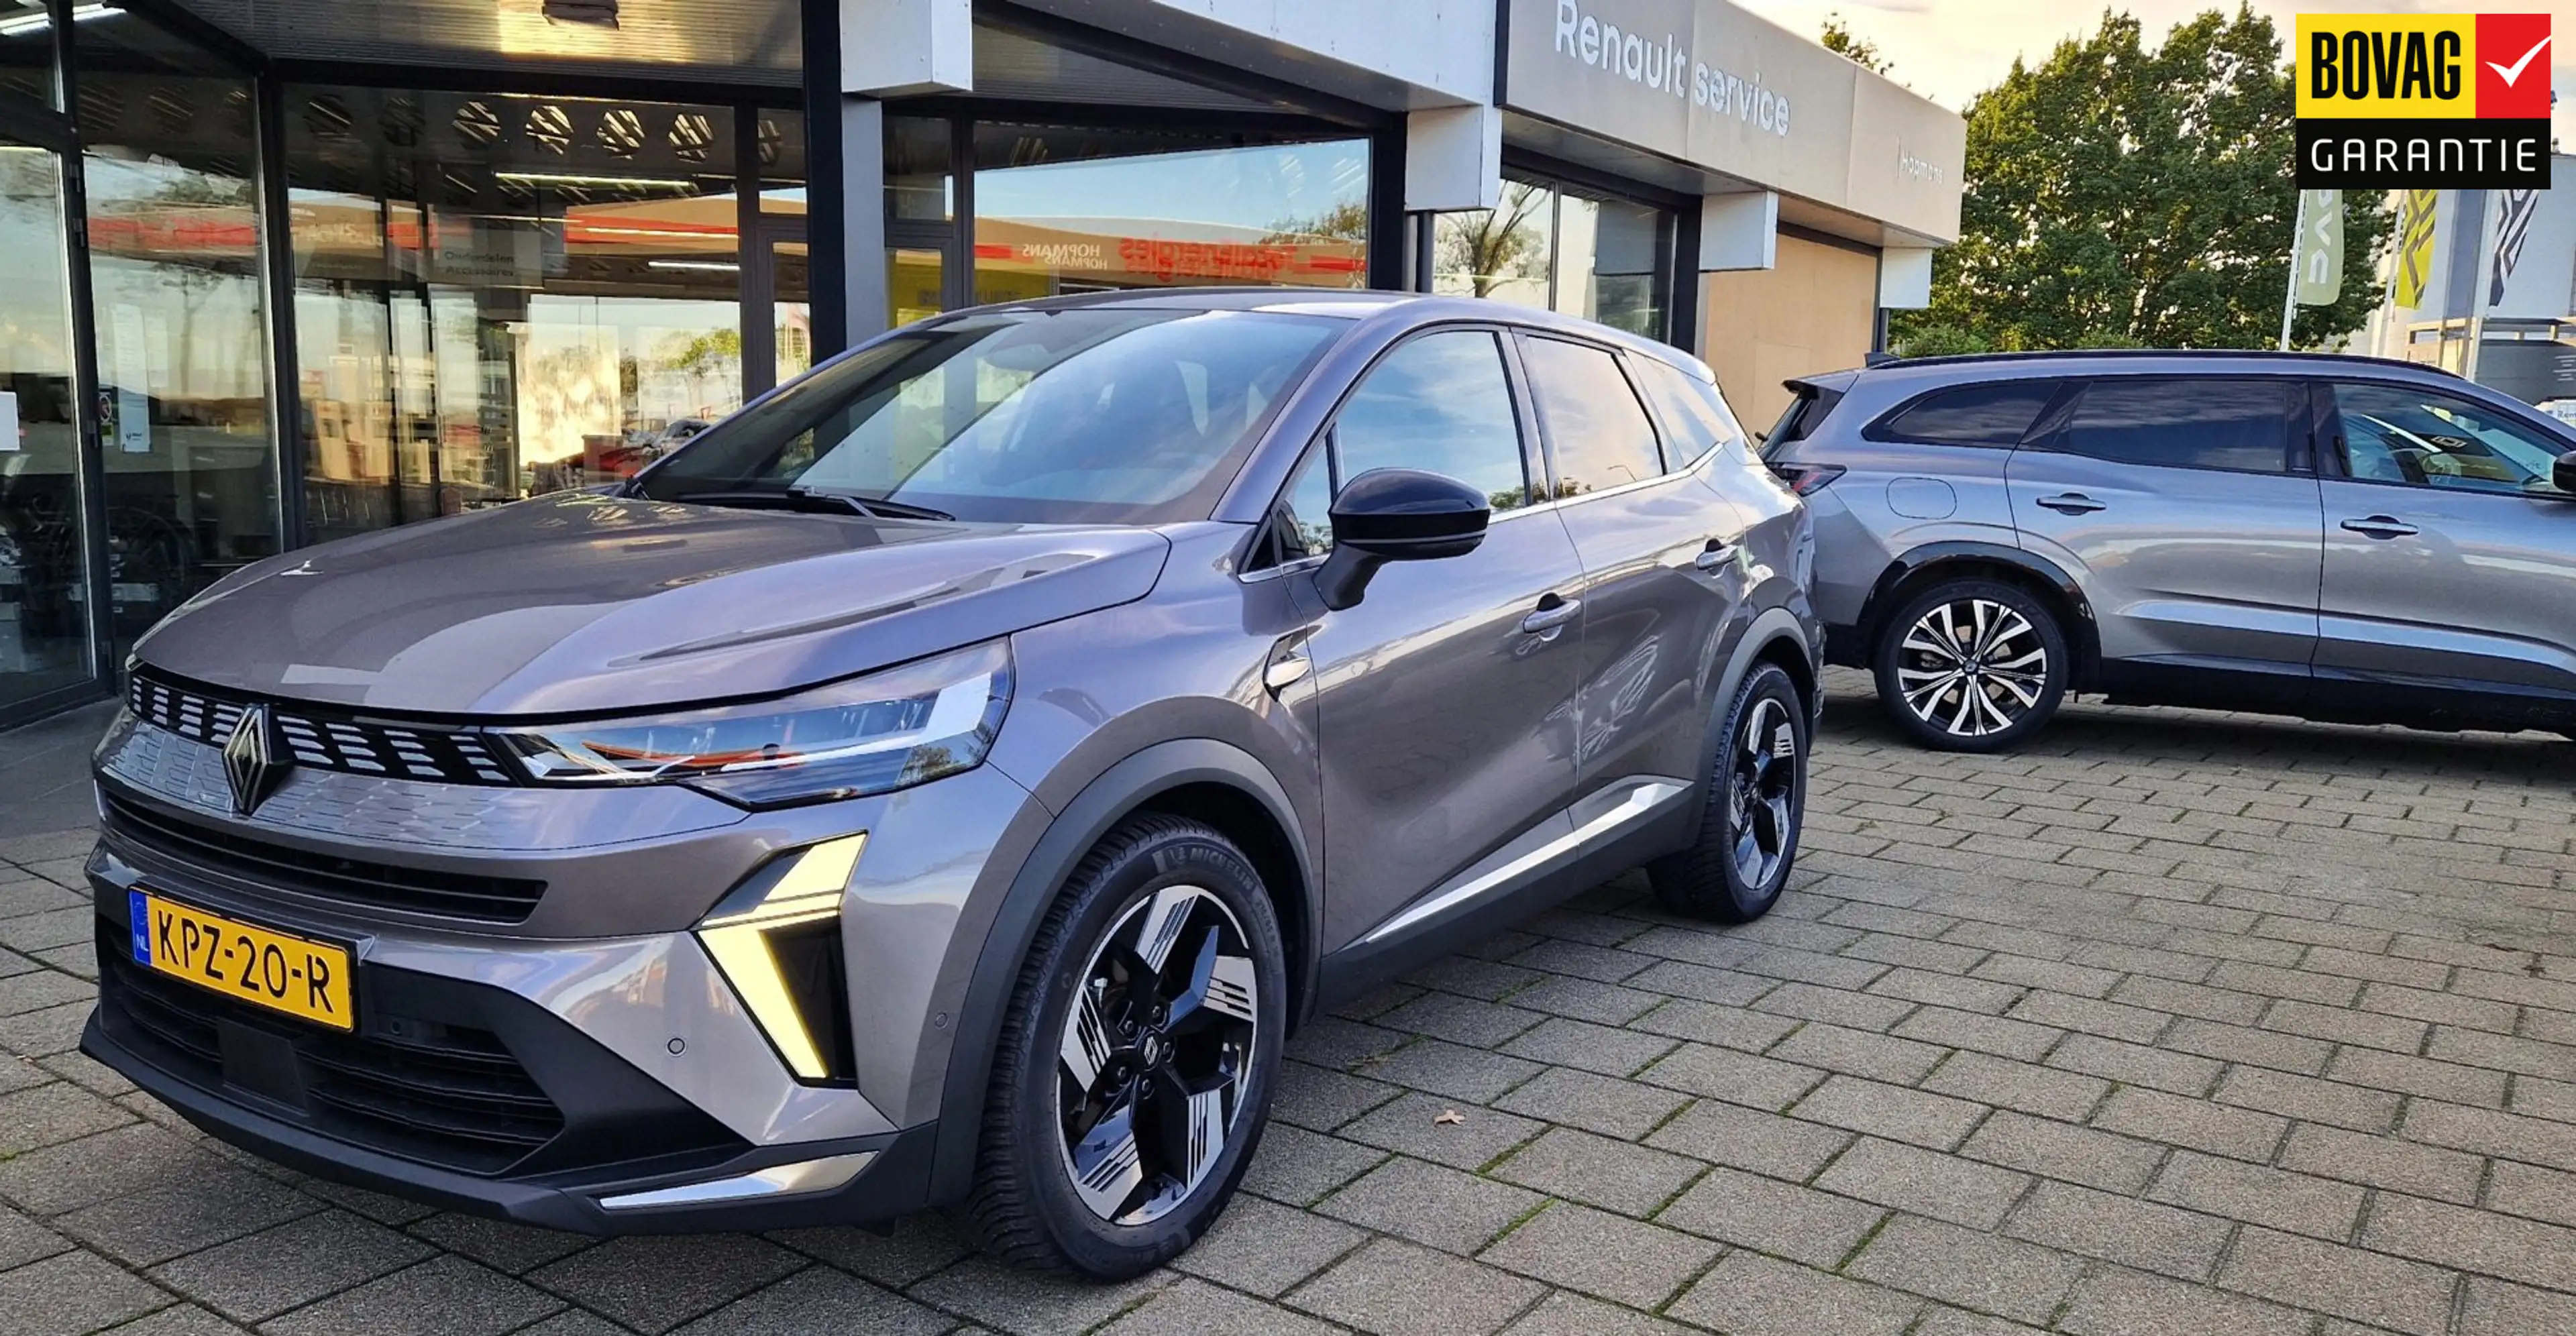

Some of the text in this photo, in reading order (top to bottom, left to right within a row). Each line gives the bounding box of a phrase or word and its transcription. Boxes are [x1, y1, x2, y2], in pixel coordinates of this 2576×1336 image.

[1556, 0, 1790, 137] Renault service
[1190, 847, 1255, 891] MICHELIN
[136, 933, 149, 952] NL
[157, 909, 334, 1013] KPZ-20-R
